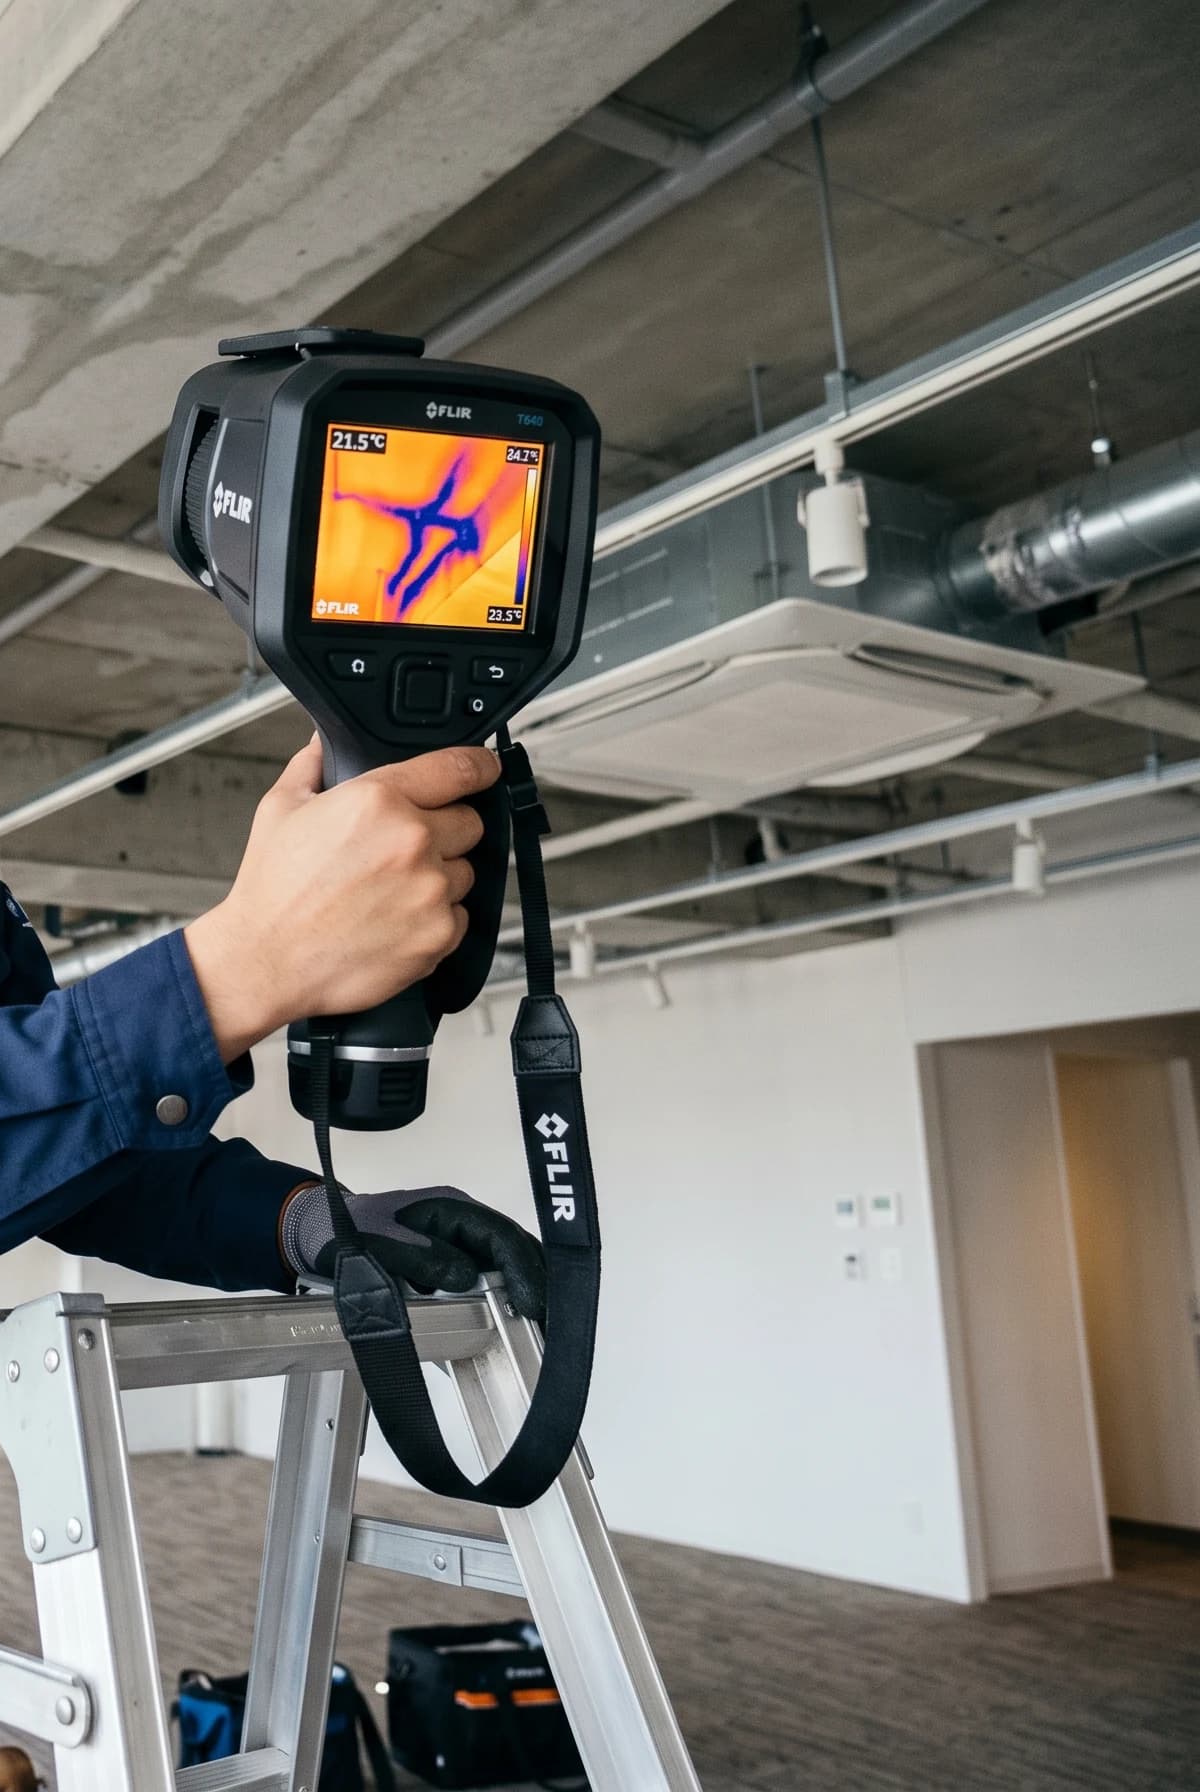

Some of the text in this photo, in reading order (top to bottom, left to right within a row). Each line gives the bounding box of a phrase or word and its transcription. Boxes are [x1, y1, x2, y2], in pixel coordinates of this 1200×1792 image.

[437, 405, 472, 420] FLIR
[516, 413, 544, 427] T640
[222, 489, 253, 524] FLIR
[327, 603, 359, 615] FLIR
[542, 1141, 576, 1222] FLIR
